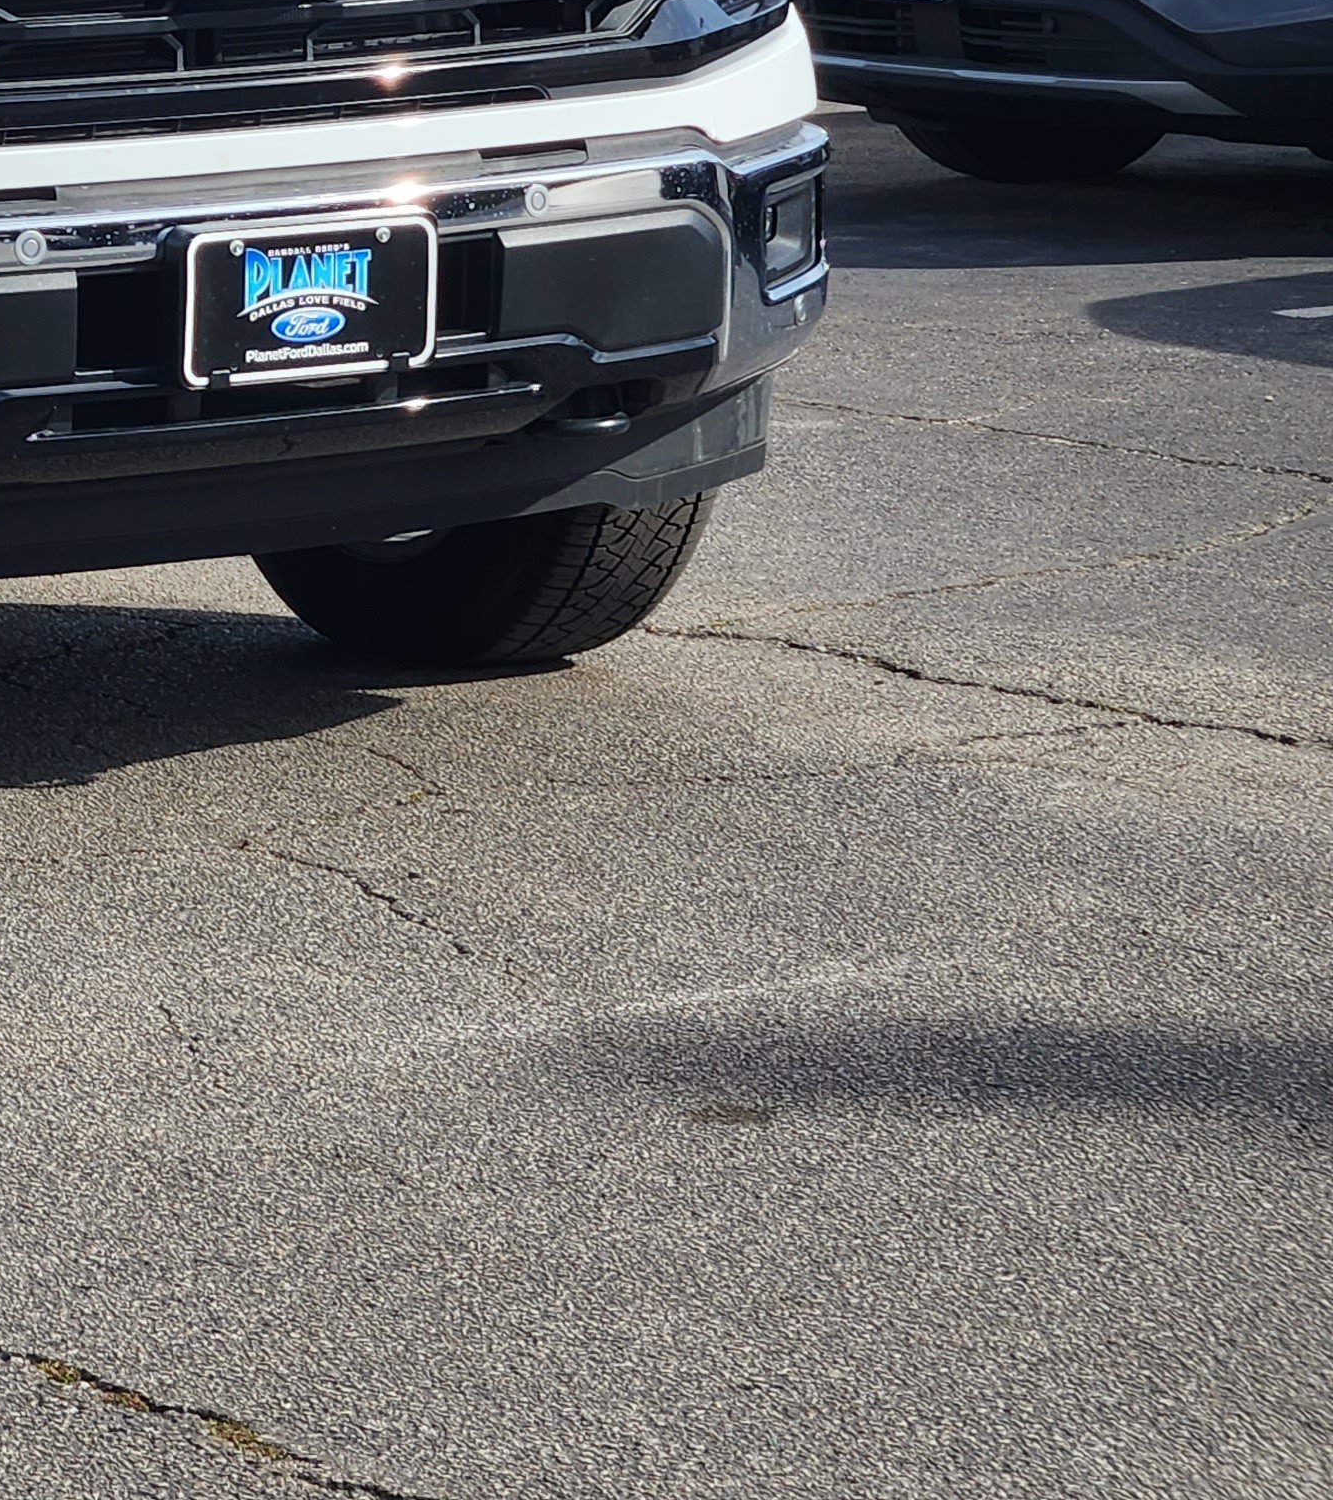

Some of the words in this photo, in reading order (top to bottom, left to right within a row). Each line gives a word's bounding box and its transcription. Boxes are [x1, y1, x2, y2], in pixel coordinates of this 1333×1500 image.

[244, 247, 372, 310] PLANET
[248, 299, 296, 322] DALLAS
[298, 295, 330, 306] LOVE
[333, 296, 367, 311] FIELD
[284, 313, 331, 337] Ford
[245, 341, 370, 364] PlanetFordDallas.com
